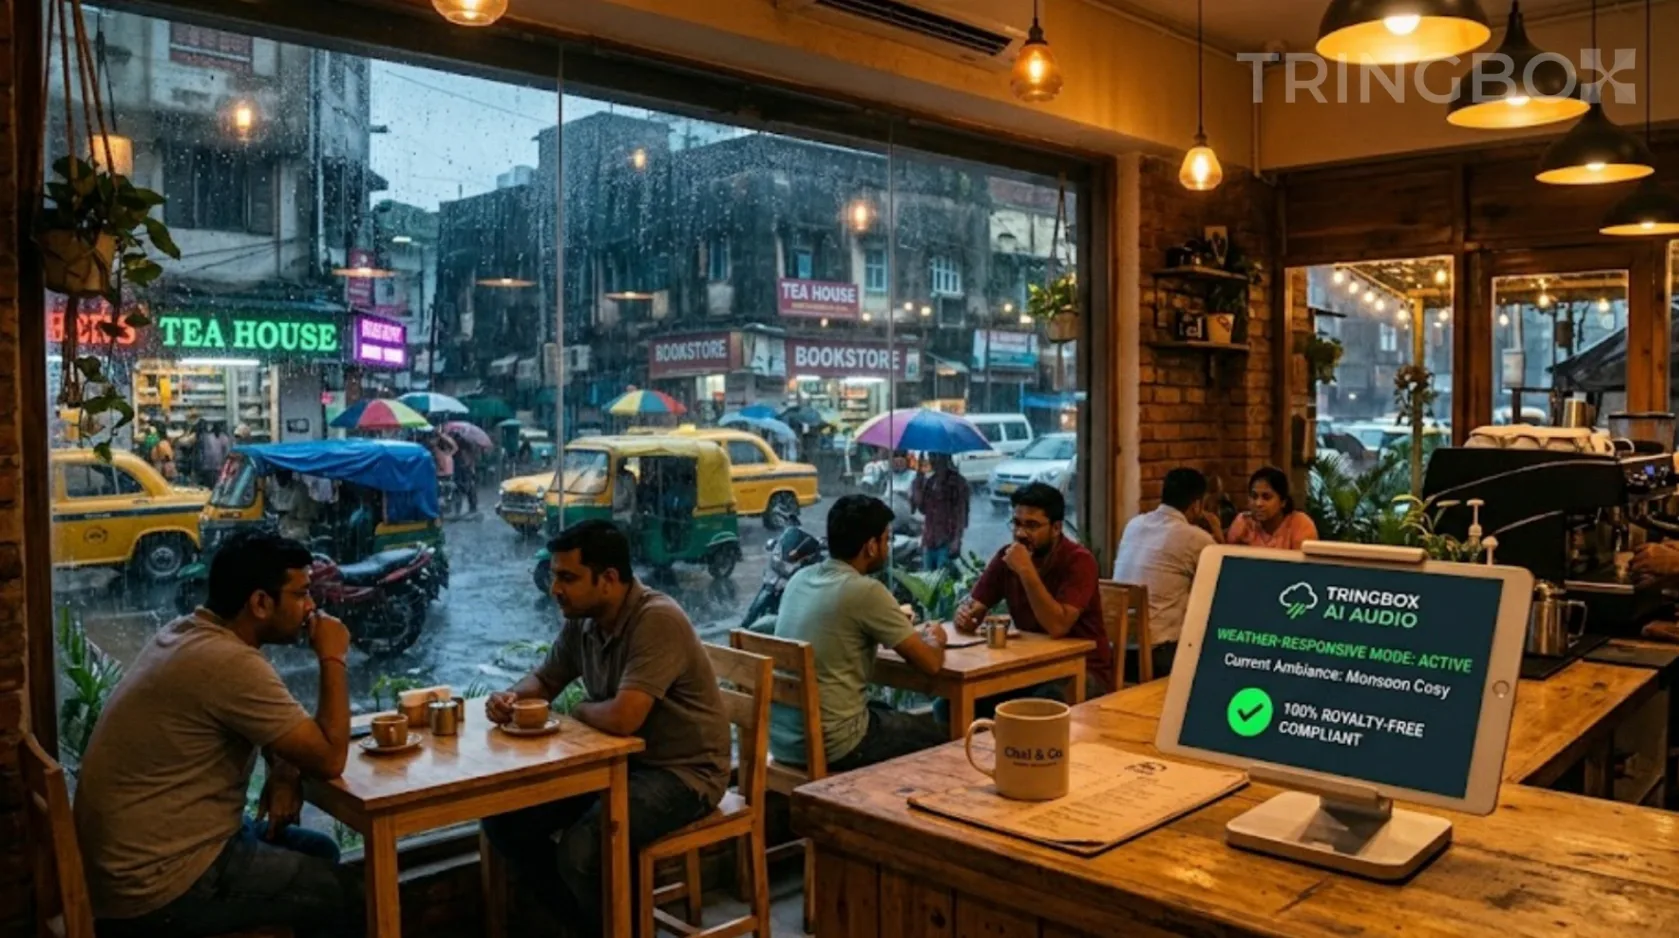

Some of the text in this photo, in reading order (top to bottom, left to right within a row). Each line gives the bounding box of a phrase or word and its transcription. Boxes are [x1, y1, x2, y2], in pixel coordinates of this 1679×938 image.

[780, 282, 856, 304] TEA HOUSE
[159, 316, 226, 349] TEA
[232, 319, 337, 352] HOUSE
[654, 339, 727, 363] BOOKSTORE
[794, 345, 901, 370] BOOKSTORE
[1326, 586, 1421, 610] TRINGBOX
[1323, 603, 1418, 628] AI AUDIO
[1217, 627, 1473, 673] WEATHER-RESPONSIVE MODE: ACTIVE
[1224, 652, 1451, 700] Current Ambiance: Monsoon Cosy
[1283, 702, 1425, 738] 100% ROYALTY-FREE
[1278, 720, 1363, 747] COMPLIANT
[1034, 747, 1045, 761] &
